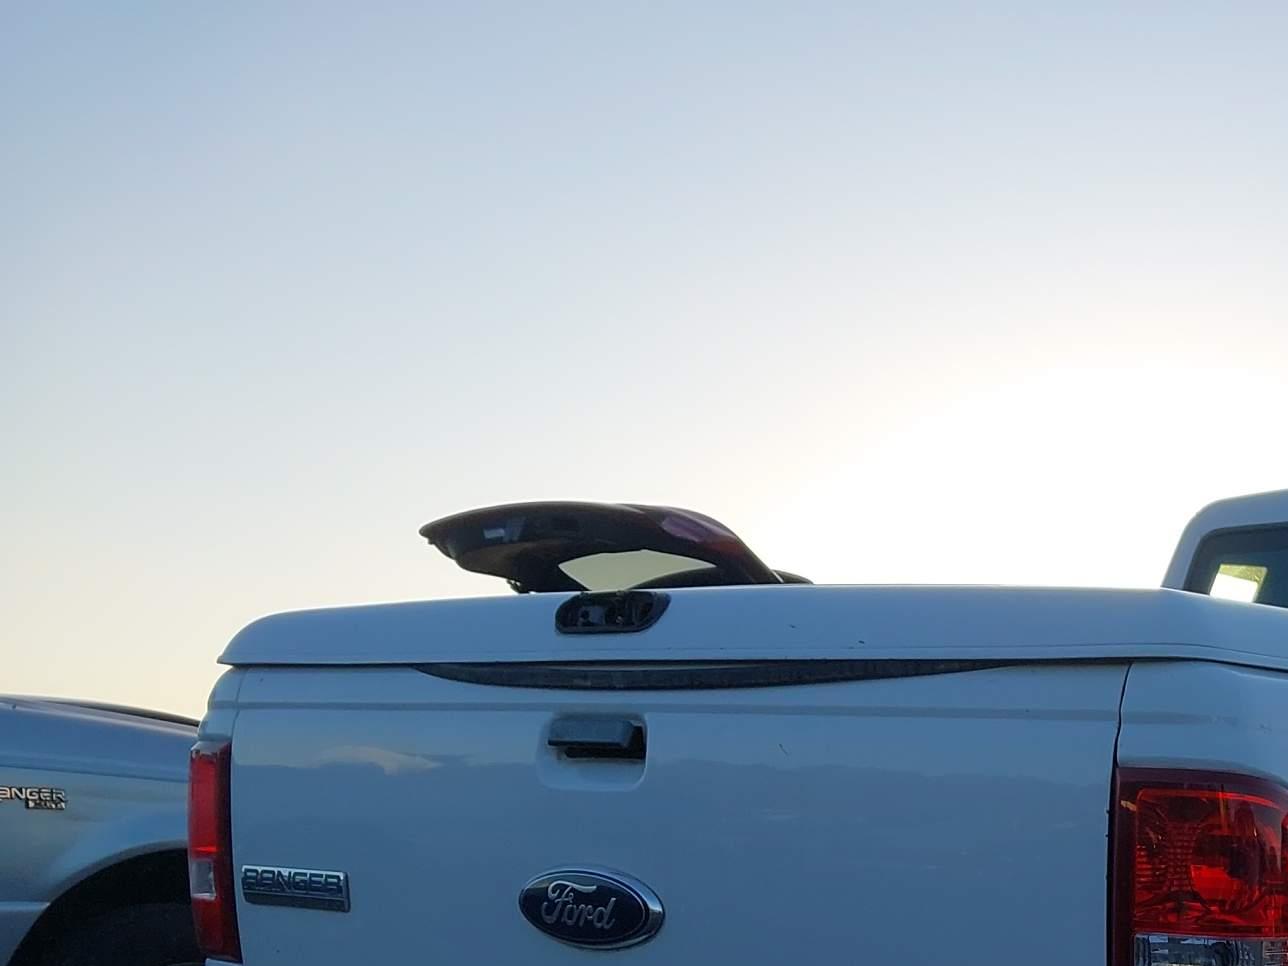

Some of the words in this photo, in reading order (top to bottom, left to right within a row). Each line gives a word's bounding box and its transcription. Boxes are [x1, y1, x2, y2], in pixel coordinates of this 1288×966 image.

[0, 785, 65, 801] ANGER
[242, 867, 344, 897] RANGER
[541, 880, 616, 929] Ford
